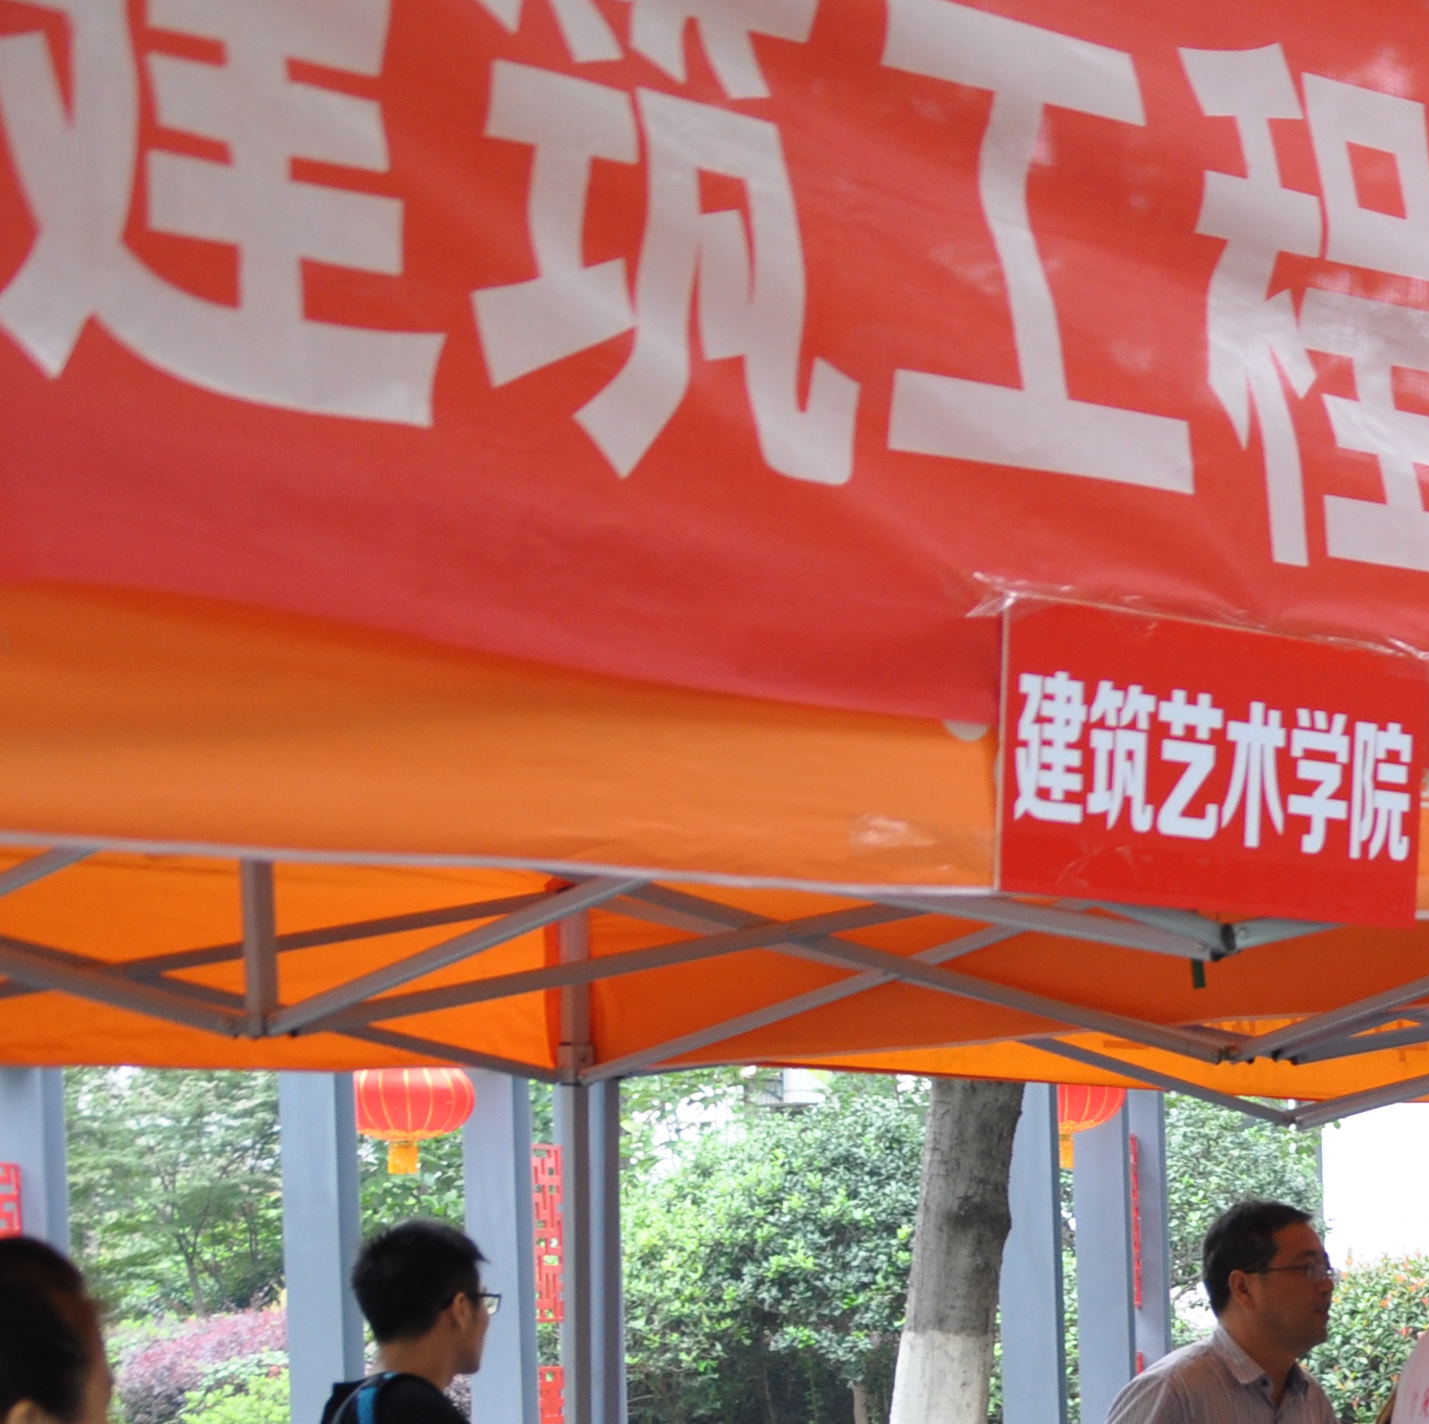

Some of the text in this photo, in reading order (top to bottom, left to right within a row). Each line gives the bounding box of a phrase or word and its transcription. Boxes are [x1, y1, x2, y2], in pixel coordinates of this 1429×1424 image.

[1014, 671, 1412, 861] 建筑艺术学院
